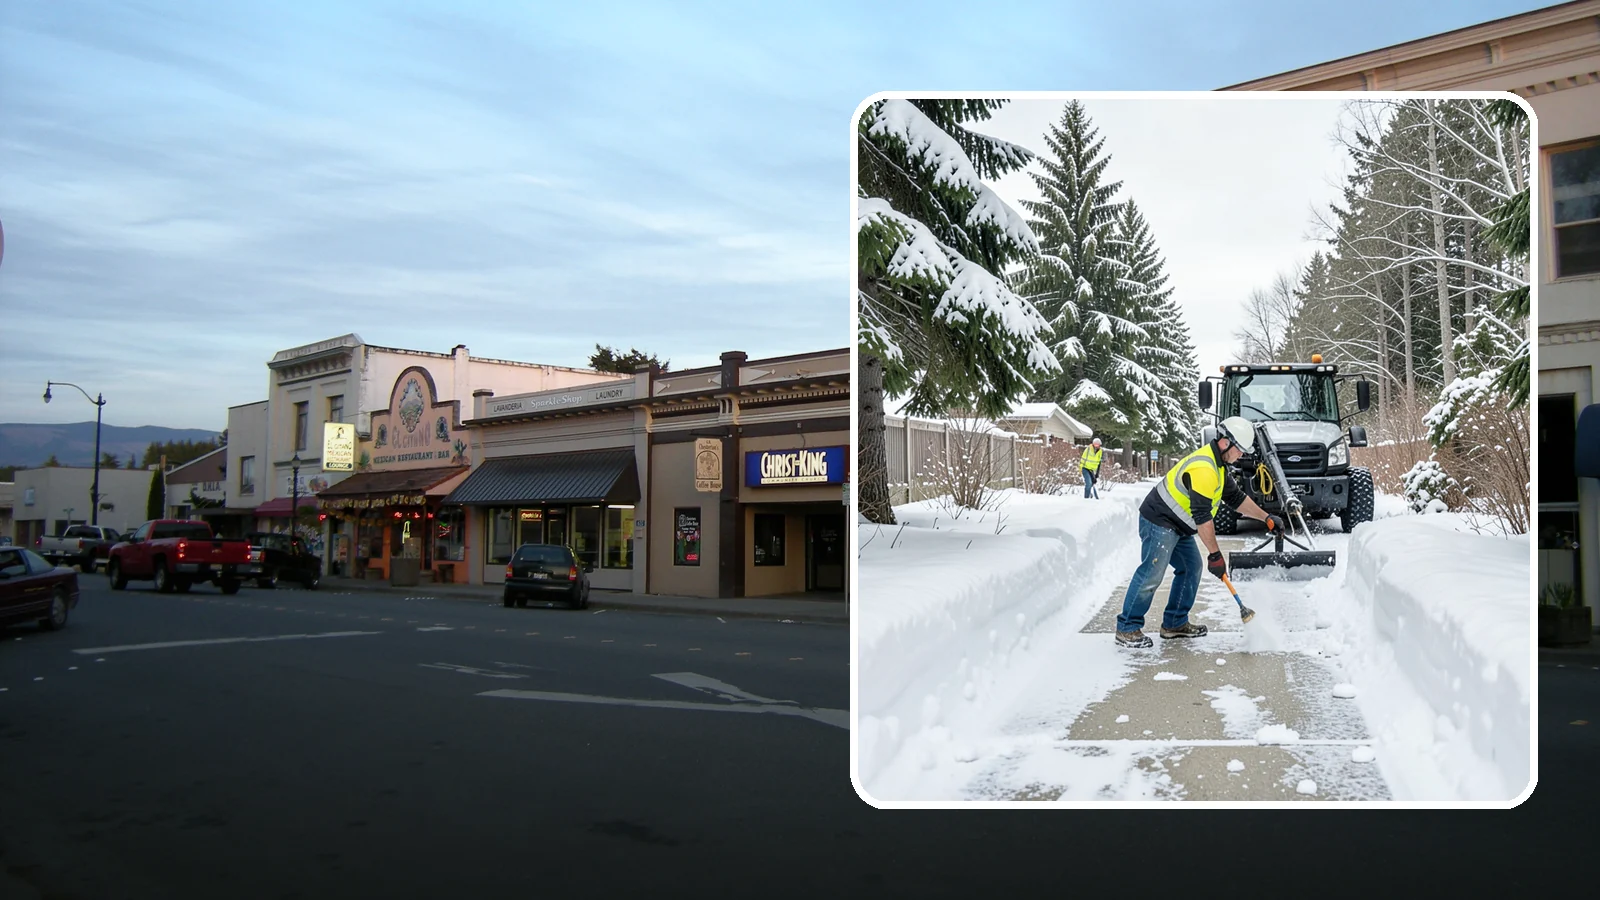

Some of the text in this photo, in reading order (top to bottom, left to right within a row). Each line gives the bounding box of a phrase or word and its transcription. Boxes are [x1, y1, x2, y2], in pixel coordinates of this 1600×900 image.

[493, 402, 523, 413] LAVANDERIA
[595, 389, 623, 400] LAUNDRY
[374, 454, 396, 464] MEXICAN
[397, 451, 433, 462] RESTAURANT
[438, 450, 450, 459] BAR
[761, 450, 827, 478] CHRIST KING
